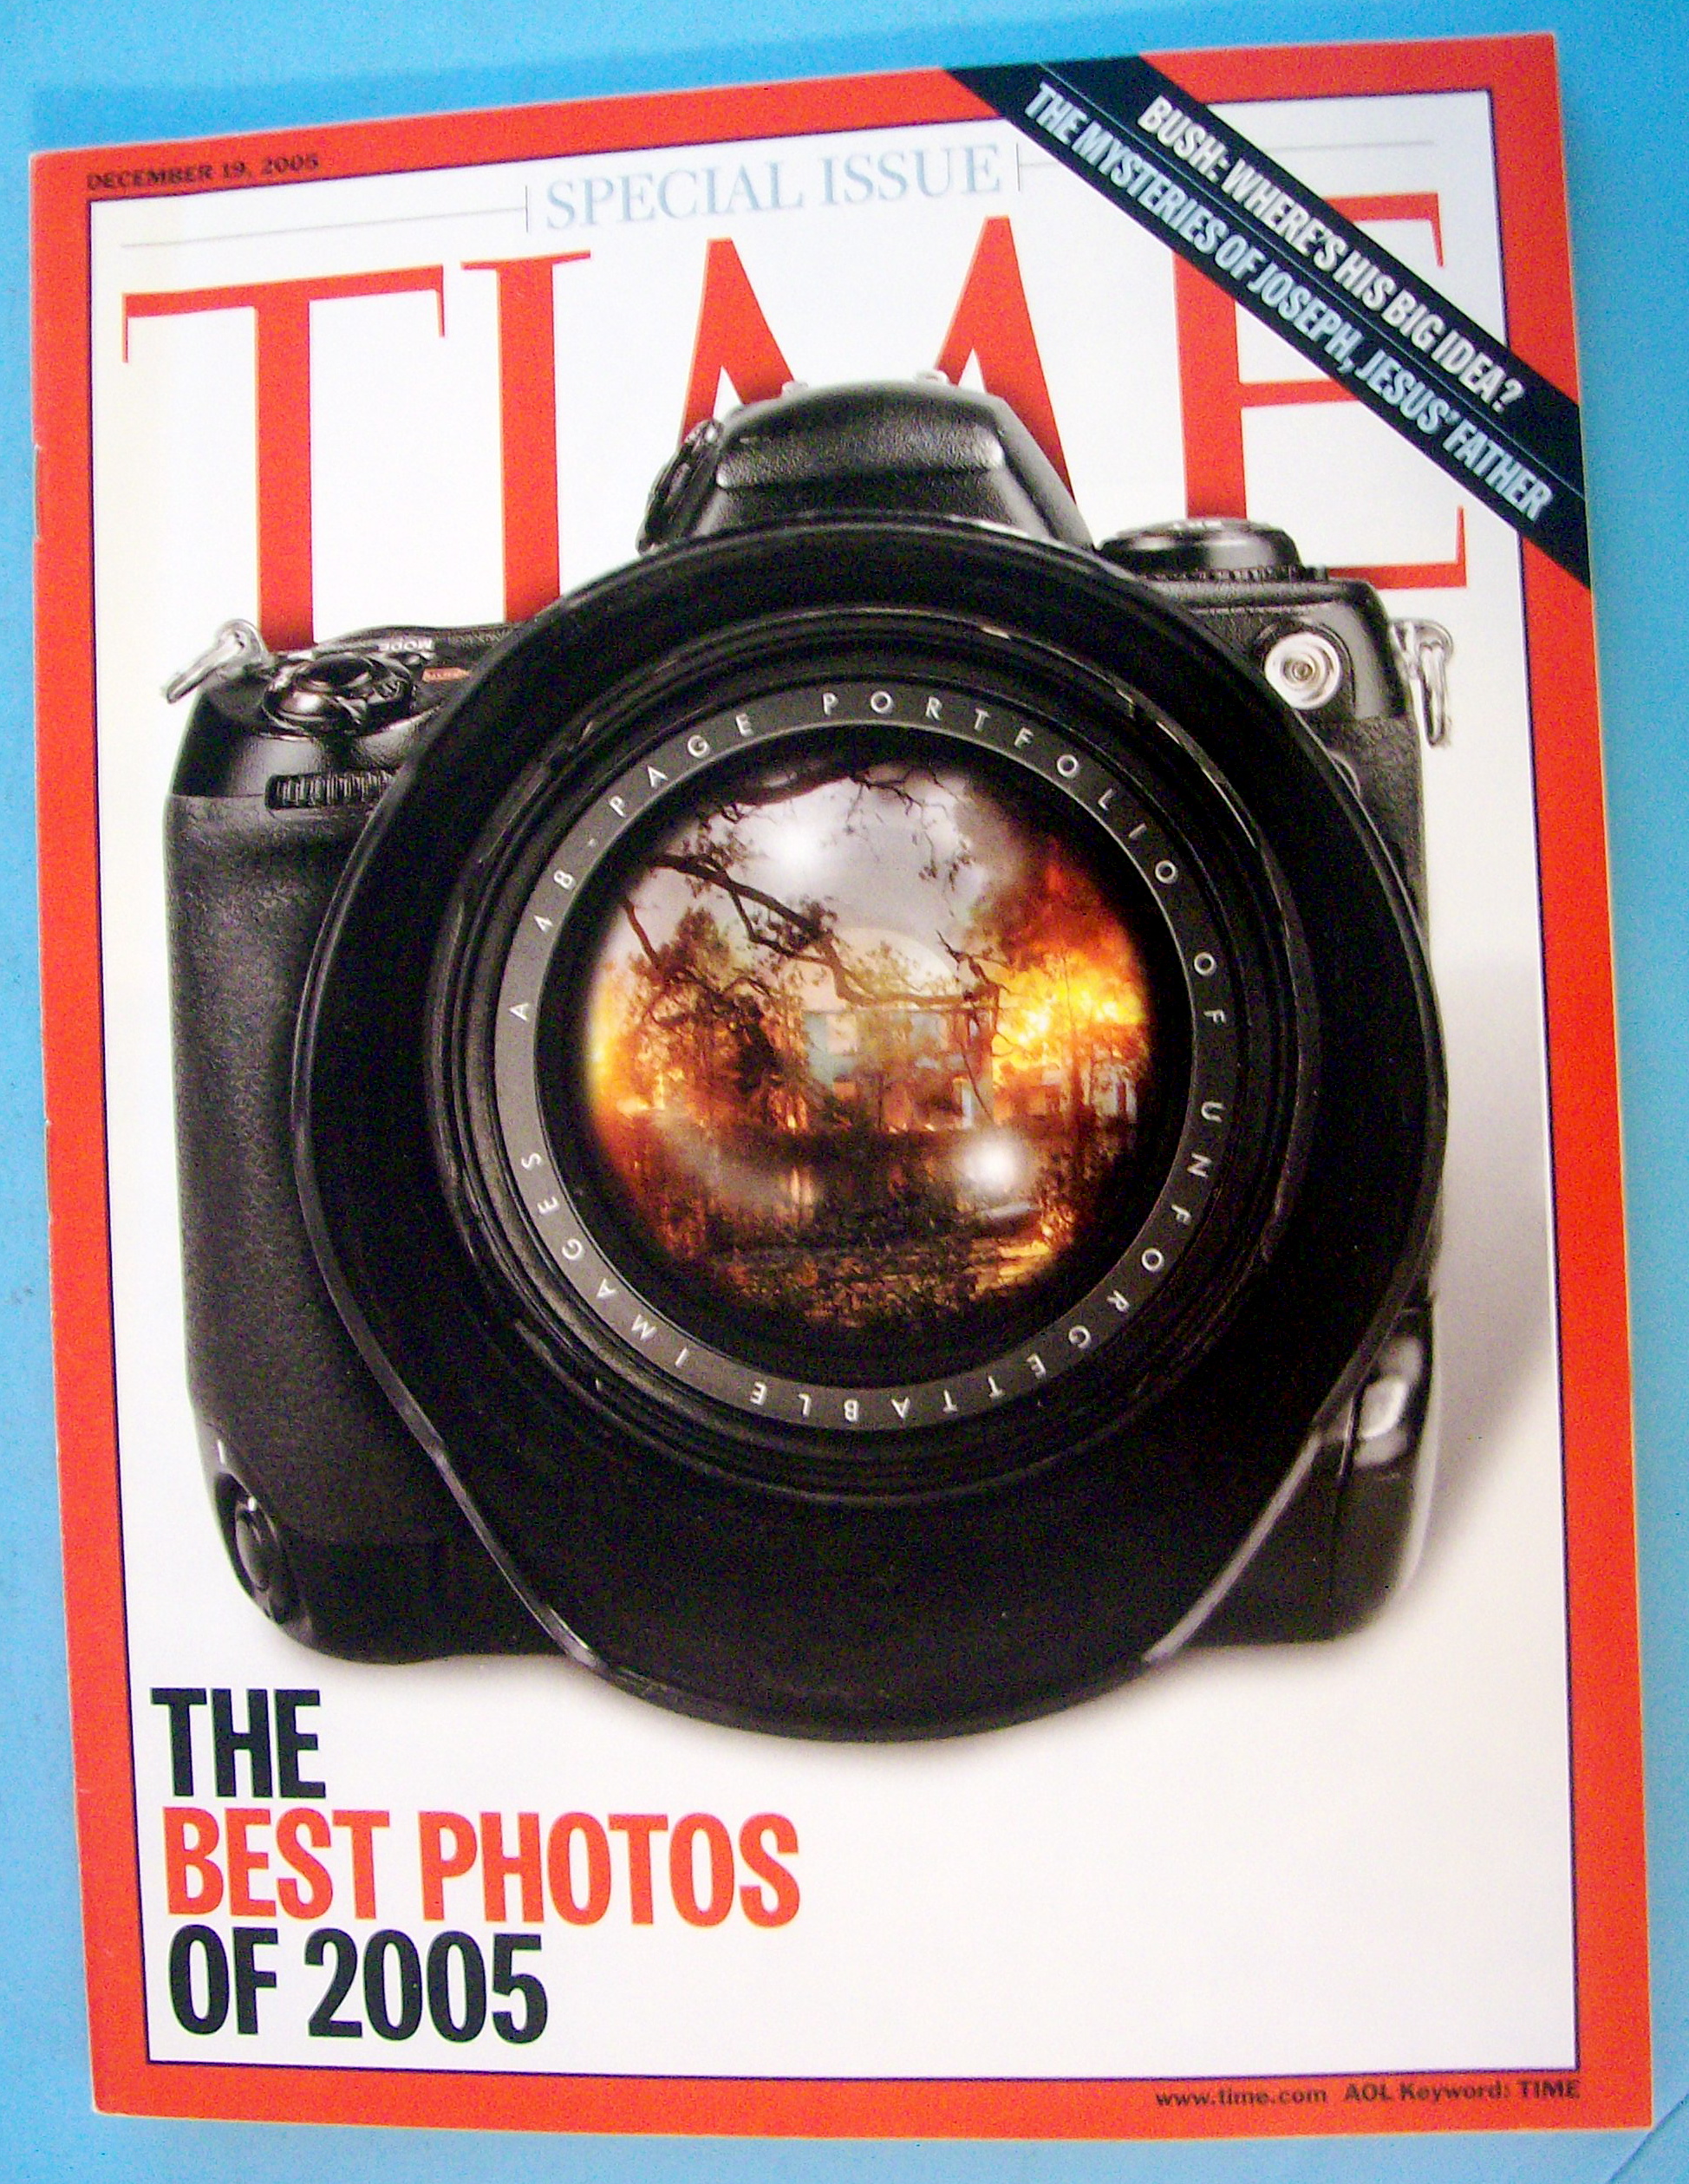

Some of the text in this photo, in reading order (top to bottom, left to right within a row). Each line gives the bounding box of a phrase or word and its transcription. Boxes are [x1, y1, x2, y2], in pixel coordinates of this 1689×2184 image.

[88, 153, 319, 191] DECEMBER 19, 2005
[546, 143, 1001, 231] SPECIAL ISSUE
[1024, 81, 1089, 145] THE
[1072, 120, 1229, 255] MYSTERIES
[1215, 234, 1267, 280] OF
[1247, 261, 1364, 375] JOSEPH,
[1442, 419, 1553, 521] FATHER
[1137, 95, 1230, 181] BUSH:
[1333, 250, 1397, 311] HIS
[1381, 289, 1445, 353] BIG
[1431, 329, 1524, 413] IDEA?
[822, 690, 1178, 884] PORTFOLIO
[509, 1001, 530, 1022] A
[1193, 951, 1227, 1025] OF
[521, 1152, 689, 1369] IMAGES
[749, 1100, 1228, 1423] UNFORGETTABLE
[150, 1687, 326, 1798] THE
[163, 1807, 799, 1928] BEST PHOTOS
[168, 1924, 548, 2044] OF 2005
[1155, 2079, 1581, 2107] www.time.com AOL Keyword: TIME
